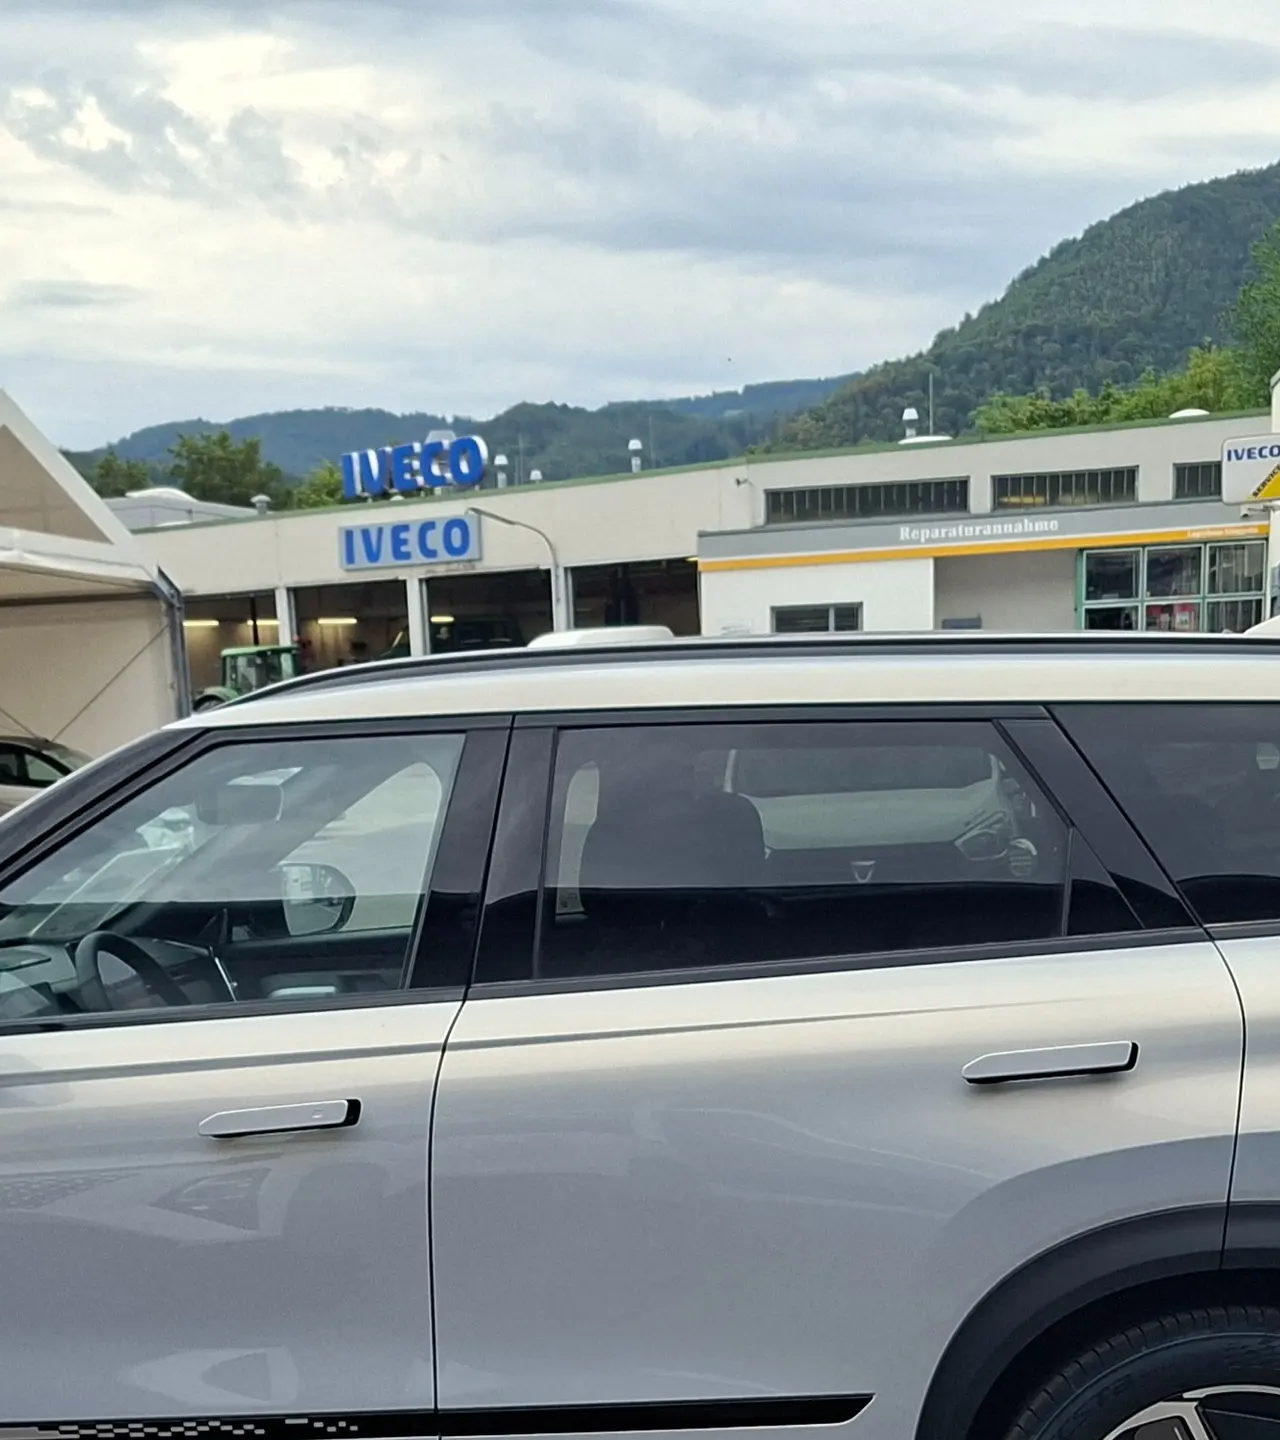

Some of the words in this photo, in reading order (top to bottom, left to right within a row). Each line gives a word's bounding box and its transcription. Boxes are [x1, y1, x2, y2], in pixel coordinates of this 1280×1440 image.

[341, 435, 487, 499] IVECO
[344, 517, 470, 566] IVECO
[899, 518, 1059, 543] Reparaturannahme
